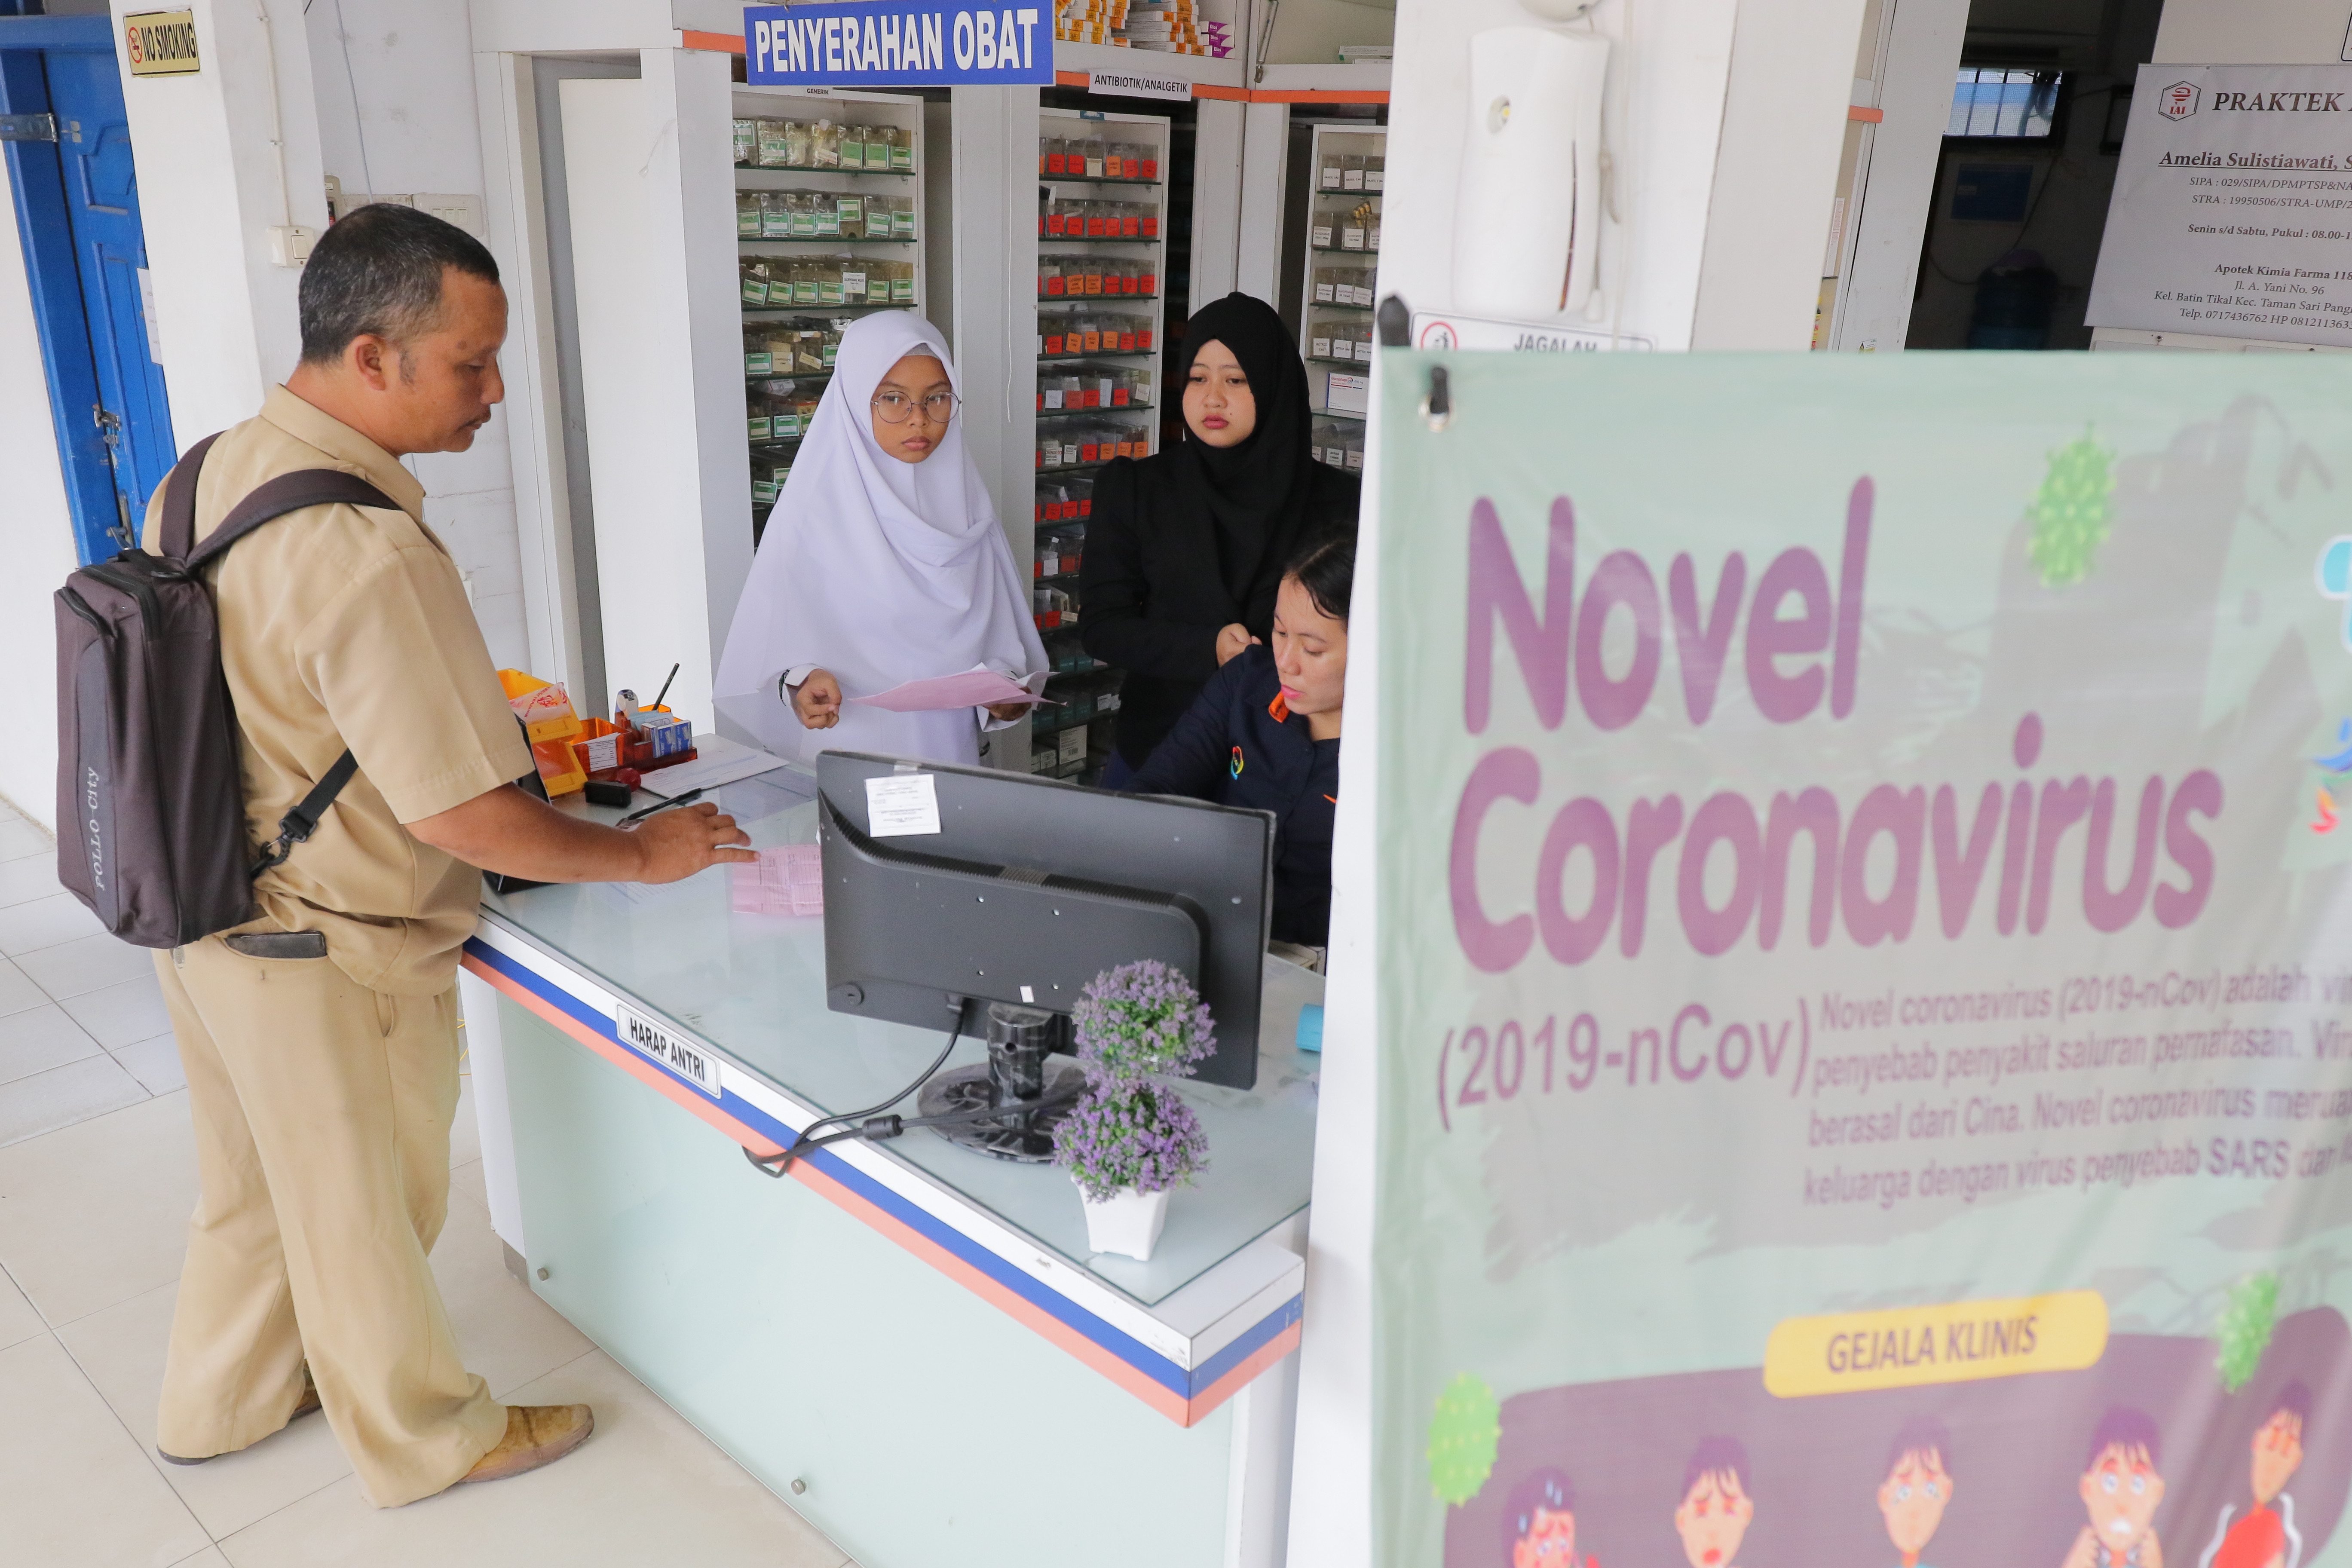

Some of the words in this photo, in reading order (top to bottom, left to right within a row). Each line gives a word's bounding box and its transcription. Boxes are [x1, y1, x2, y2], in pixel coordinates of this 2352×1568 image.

[141, 26, 155, 61] NO
[155, 22, 196, 61] SMOKING
[754, 12, 943, 72] PENYERAHAN
[953, 8, 1038, 70] OBAT
[1094, 74, 1188, 93] ANTIBIOTIK/ANALGETIK
[2211, 92, 2345, 111] PRAKTEK
[2169, 106, 2186, 114] IAI
[2159, 150, 2222, 166] Amelia
[2226, 152, 2338, 171] Sulistiawati,
[2189, 177, 2212, 186] SIPA
[2192, 195, 2220, 204] STRA
[2188, 224, 2216, 234] Senin
[2219, 226, 2235, 234] s/d
[2236, 226, 2268, 237] Sabtu,
[2272, 228, 2303, 238] Pukul
[2214, 264, 2254, 275] Apotek
[2256, 266, 2291, 276] Kimia
[2293, 268, 2330, 279] Farma
[2234, 280, 2244, 291] Jl.
[2248, 282, 2259, 291] A.
[2264, 282, 2286, 292] Yani
[2289, 284, 2307, 294] No.
[2311, 286, 2325, 295] 96
[2154, 291, 2173, 300] Kel.
[2176, 292, 2202, 303] Batin
[2206, 294, 2233, 305] Tikal
[2235, 296, 2256, 306] Kec.
[2261, 298, 2296, 309] Taman
[2299, 300, 2321, 311] Sari
[2323, 303, 2352, 316] Pang
[2180, 308, 2202, 320] Telp.
[2205, 310, 2267, 323] 0717436762
[2270, 315, 2288, 324] HP
[1464, 474, 1875, 736] Novel
[87, 767, 99, 810] City
[89, 819, 105, 891] POLLO
[1449, 712, 2223, 974] Coronavirus
[1819, 988, 1895, 1030] Novel
[1901, 982, 2052, 1026] coronavirus
[2057, 968, 2221, 1023] (2019-nCov)
[2226, 964, 2311, 1004] adalah
[630, 1017, 667, 1057] HARAP
[671, 1042, 705, 1082] ANTRI
[1438, 997, 1810, 1133] (2019-nCov)
[1811, 1040, 1937, 1098] penyebab
[1942, 1034, 2051, 1088] penyakit
[2056, 1031, 2147, 1071] saluran
[1808, 1102, 1903, 1147] berasal
[1907, 1099, 1959, 1139] dari
[1963, 1096, 2024, 1136] Cina.
[2032, 1087, 2103, 1128] Novel
[2109, 1080, 2255, 1125] coronavirus
[1804, 1165, 1911, 1210] keluarga
[1917, 1160, 2009, 1204] dengan
[2017, 1149, 2076, 1190] virus
[2082, 1139, 2200, 1194] penyebab
[2208, 1137, 2291, 1179] SARS
[1827, 1327, 1936, 1373] GEJALA
[1945, 1315, 2040, 1363] KLINIS
